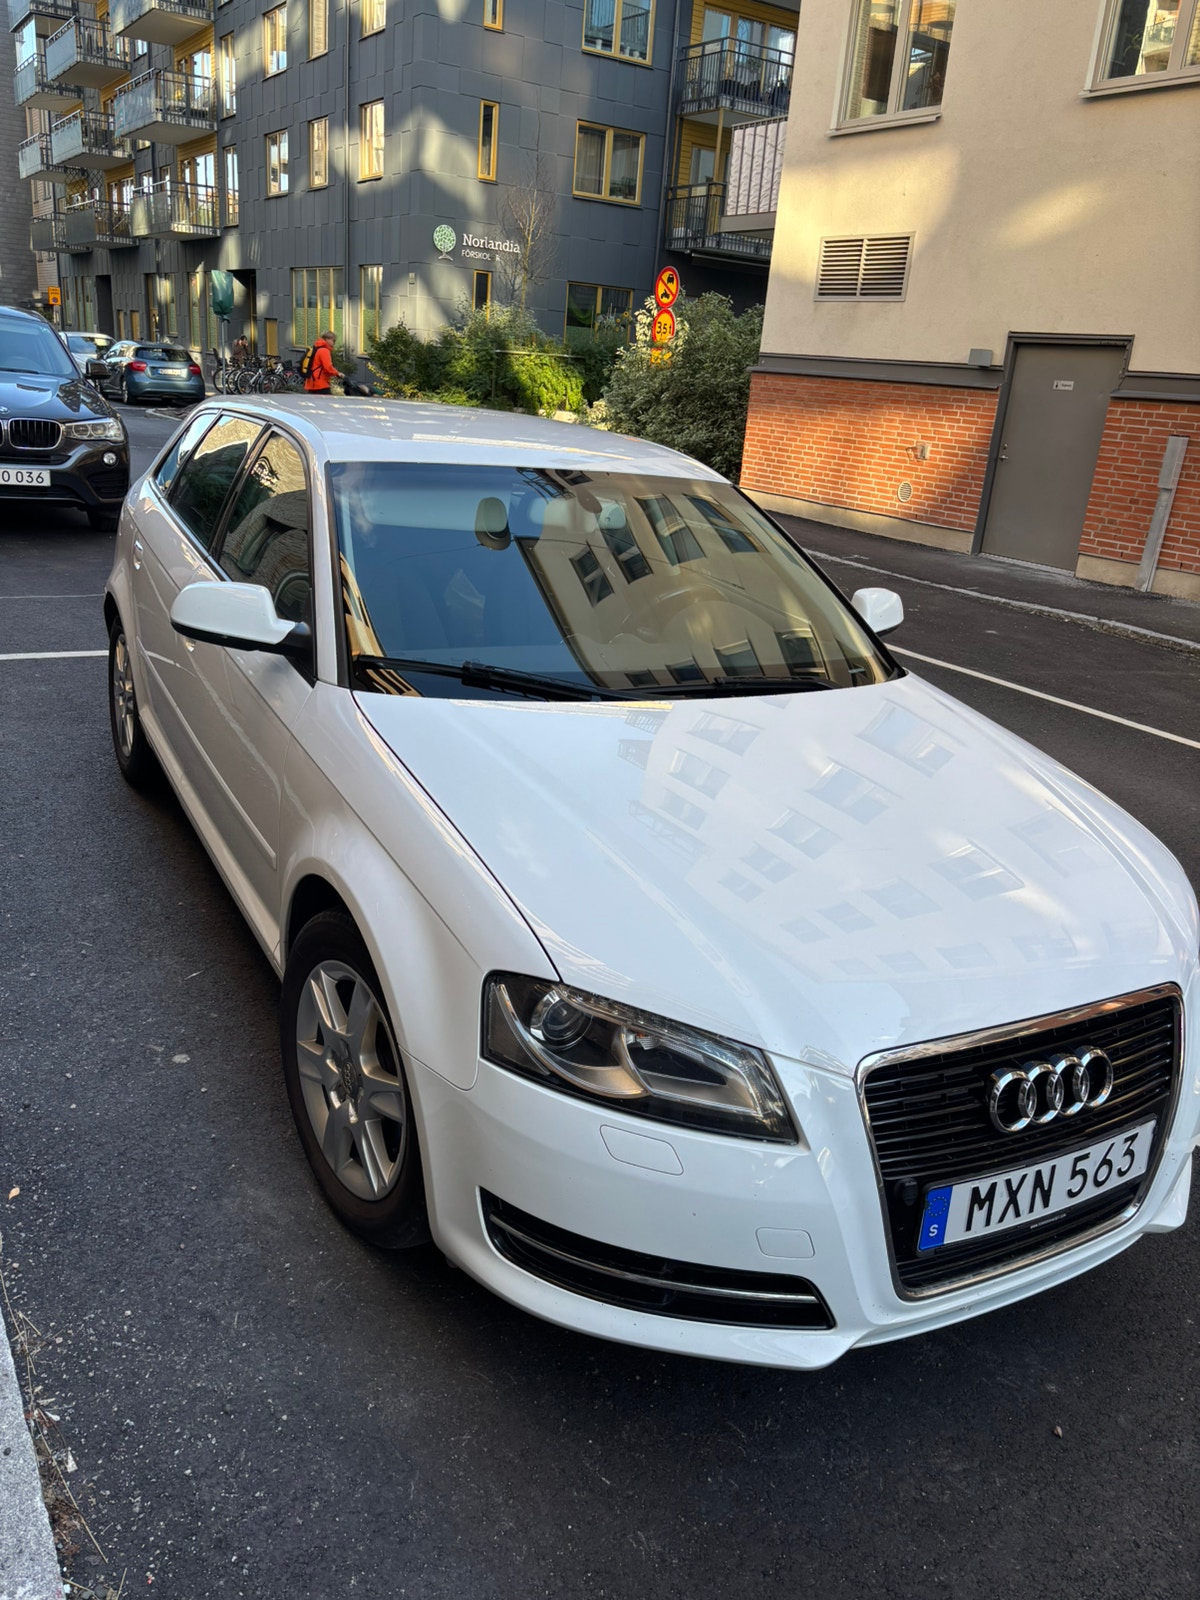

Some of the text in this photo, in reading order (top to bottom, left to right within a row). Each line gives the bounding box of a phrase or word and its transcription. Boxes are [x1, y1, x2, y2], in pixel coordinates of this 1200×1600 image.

[462, 233, 521, 254] Norlandia
[656, 321, 668, 337] 3,5
[15, 470, 45, 484] 036
[965, 1132, 1139, 1232] MXN 563
[928, 1224, 938, 1237] S
